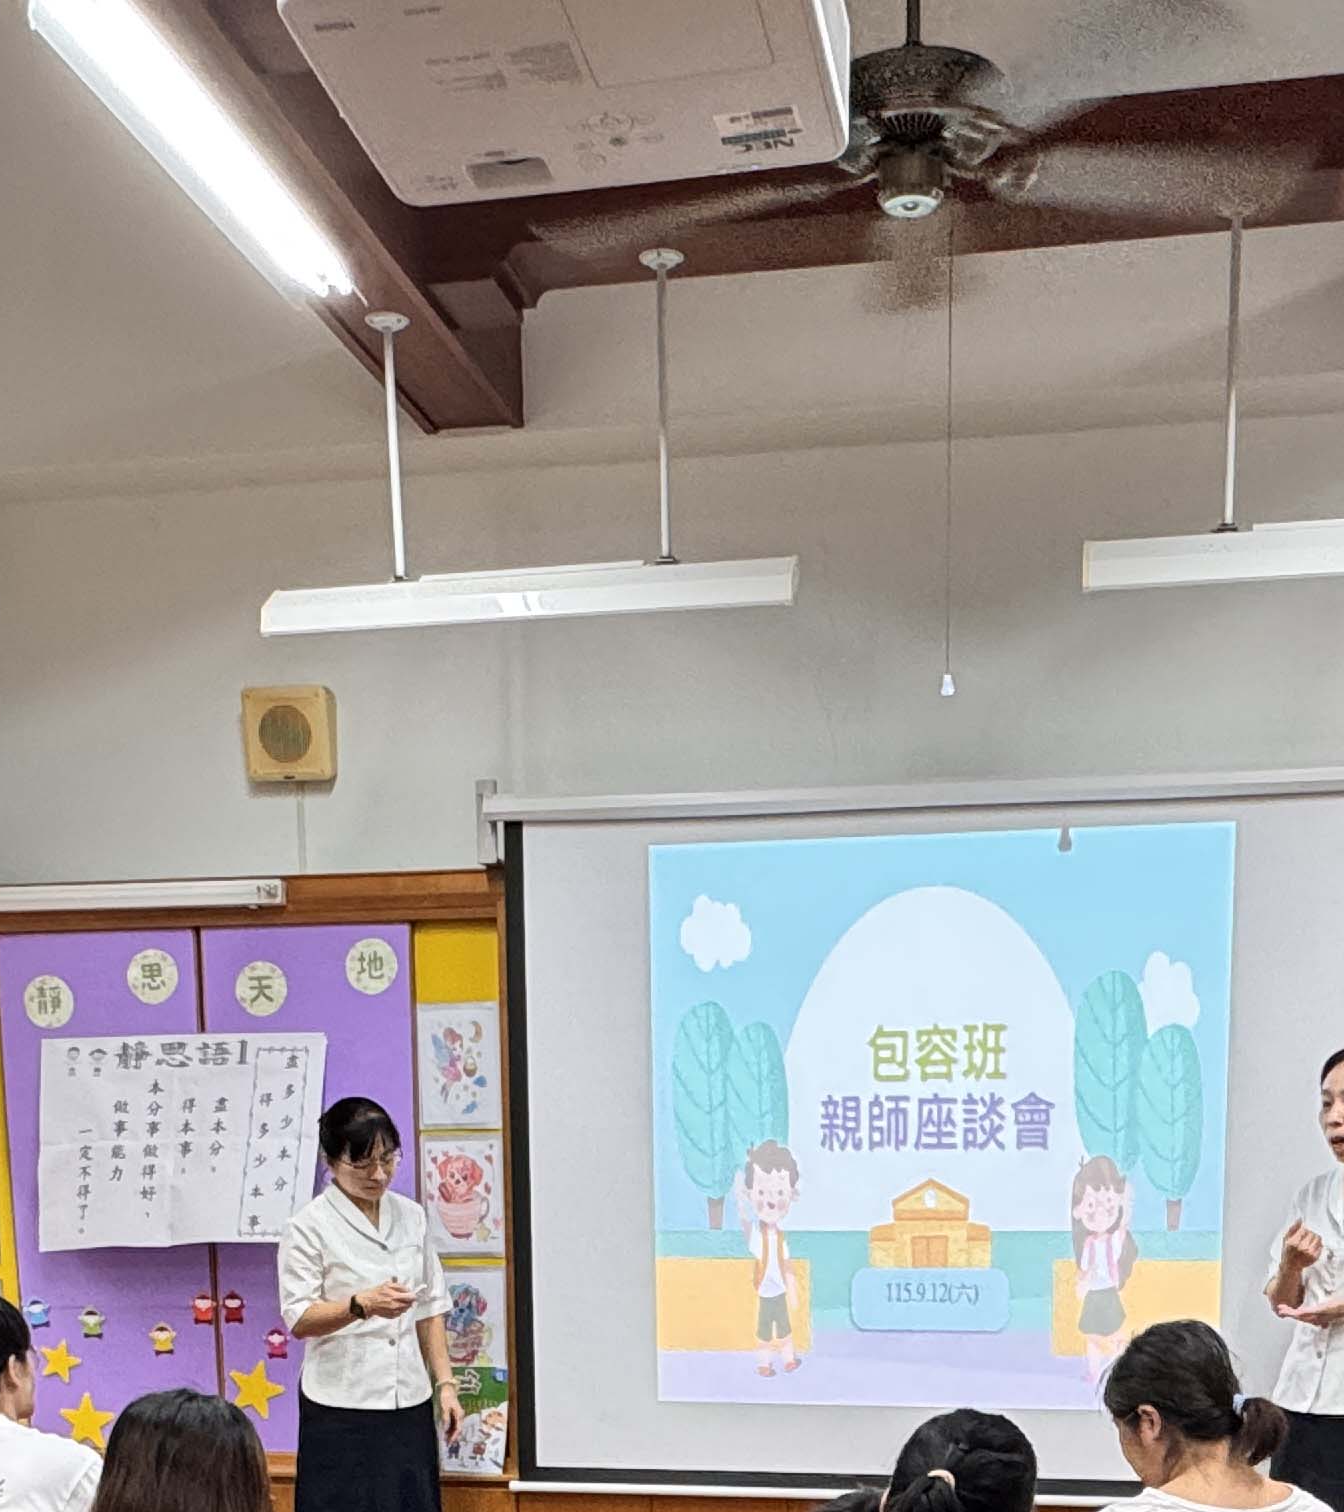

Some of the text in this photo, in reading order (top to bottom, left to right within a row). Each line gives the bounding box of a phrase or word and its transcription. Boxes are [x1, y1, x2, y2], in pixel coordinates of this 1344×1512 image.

[867, 1023, 1008, 1083] 包容班
[819, 1092, 1056, 1151] 親師座談會
